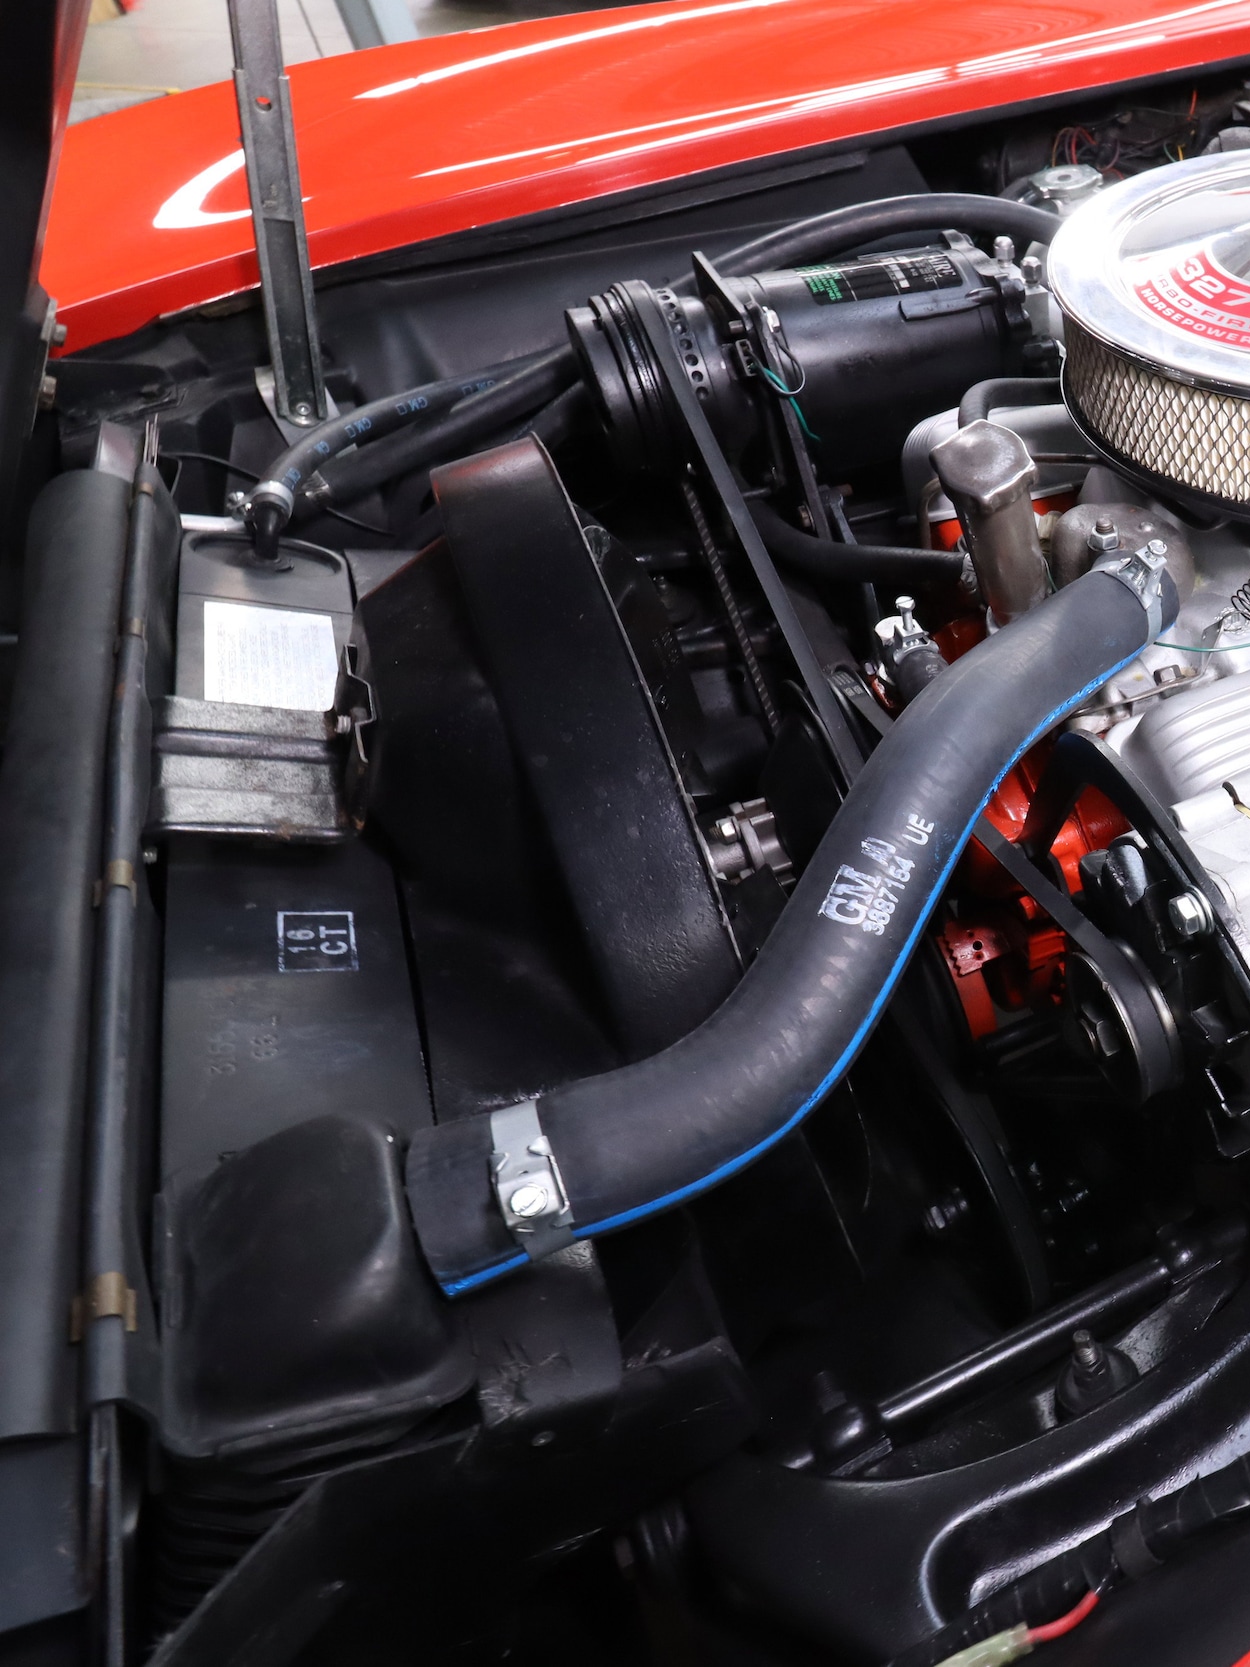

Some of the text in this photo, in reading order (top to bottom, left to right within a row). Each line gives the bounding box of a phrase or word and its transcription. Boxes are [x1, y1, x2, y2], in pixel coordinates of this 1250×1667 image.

[407, 396, 428, 412] GM
[902, 813, 935, 846] UE
[818, 864, 882, 925] GM
[286, 929, 316, 954] 16
[319, 925, 348, 955] CT
